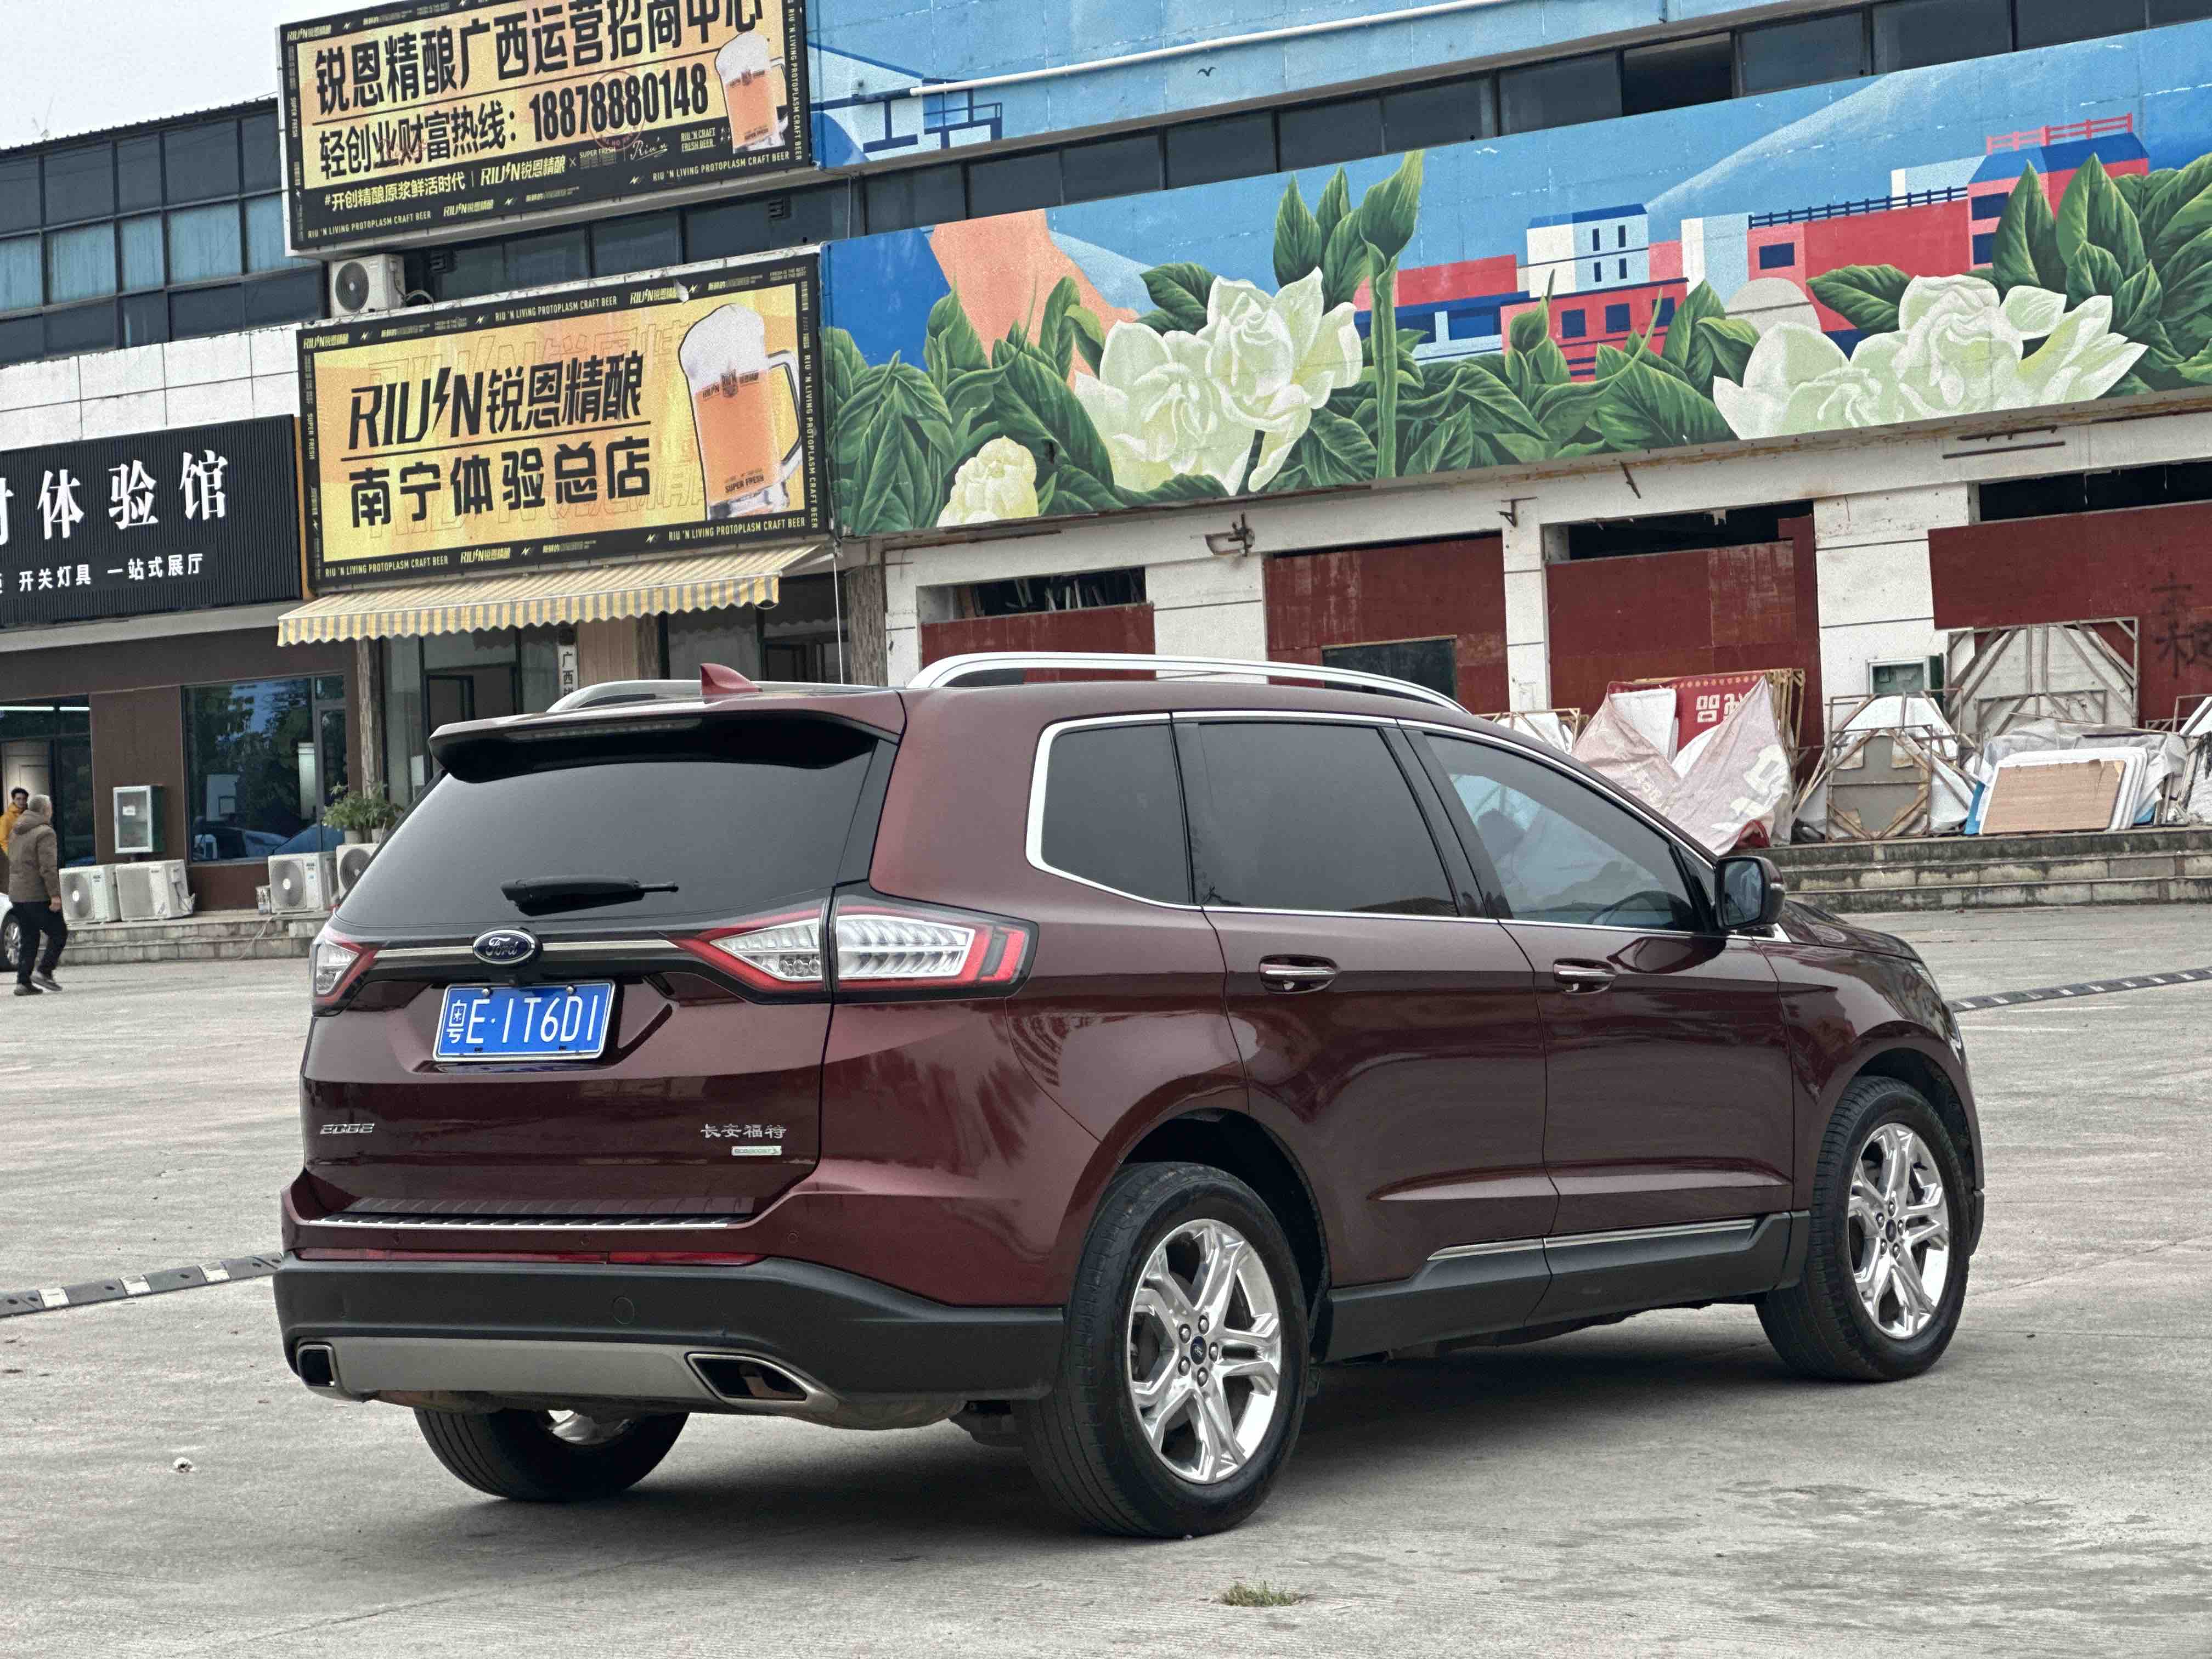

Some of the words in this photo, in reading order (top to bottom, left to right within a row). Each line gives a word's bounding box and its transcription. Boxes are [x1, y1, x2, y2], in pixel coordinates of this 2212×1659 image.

[791, 63, 799, 112] PROTOPLASM
[530, 63, 708, 143] 18878880148
[698, 127, 716, 138] CRAFT
[793, 115, 801, 137] CRAFT
[579, 149, 597, 159] SUPER
[599, 147, 616, 156] FRESH
[653, 172, 664, 181] RIU
[676, 166, 699, 177] LIVING
[701, 159, 746, 173] PROTOPLASM
[748, 154, 769, 166] CRAFT
[772, 151, 789, 162] BEER
[308, 229, 318, 239] RIU
[329, 223, 349, 234] LIVING
[352, 217, 392, 230] PROTOPLASM
[394, 213, 413, 224] CRAFT
[416, 210, 431, 220] BEER
[495, 311, 506, 321] RIU
[516, 307, 535, 318] LIVING
[538, 302, 578, 315] PROTOPLASM
[580, 298, 599, 310] CRAFT
[601, 296, 617, 307] BEER
[807, 417, 815, 475] PROTOPLASM
[349, 436, 650, 528] 南宁体验总店
[725, 478, 744, 493] SUPER
[746, 474, 764, 486] FRESH
[669, 531, 680, 541] RIU
[692, 527, 714, 538] LIVING
[716, 522, 761, 536] PROTOPLASM
[764, 520, 785, 531] CRAFT
[788, 517, 805, 528] BEER
[19, 564, 92, 592] 开关灯具
[107, 553, 204, 580] 一站式展厅
[325, 568, 336, 578] RIU
[347, 565, 367, 575] LIVING
[369, 559, 409, 573] PROTOPLASM
[411, 557, 430, 567] CRAFT
[433, 556, 448, 566] BEER
[485, 937, 518, 956] Ford
[320, 1123, 375, 1135] EDGE
[700, 1124, 787, 1138] 长安福特
